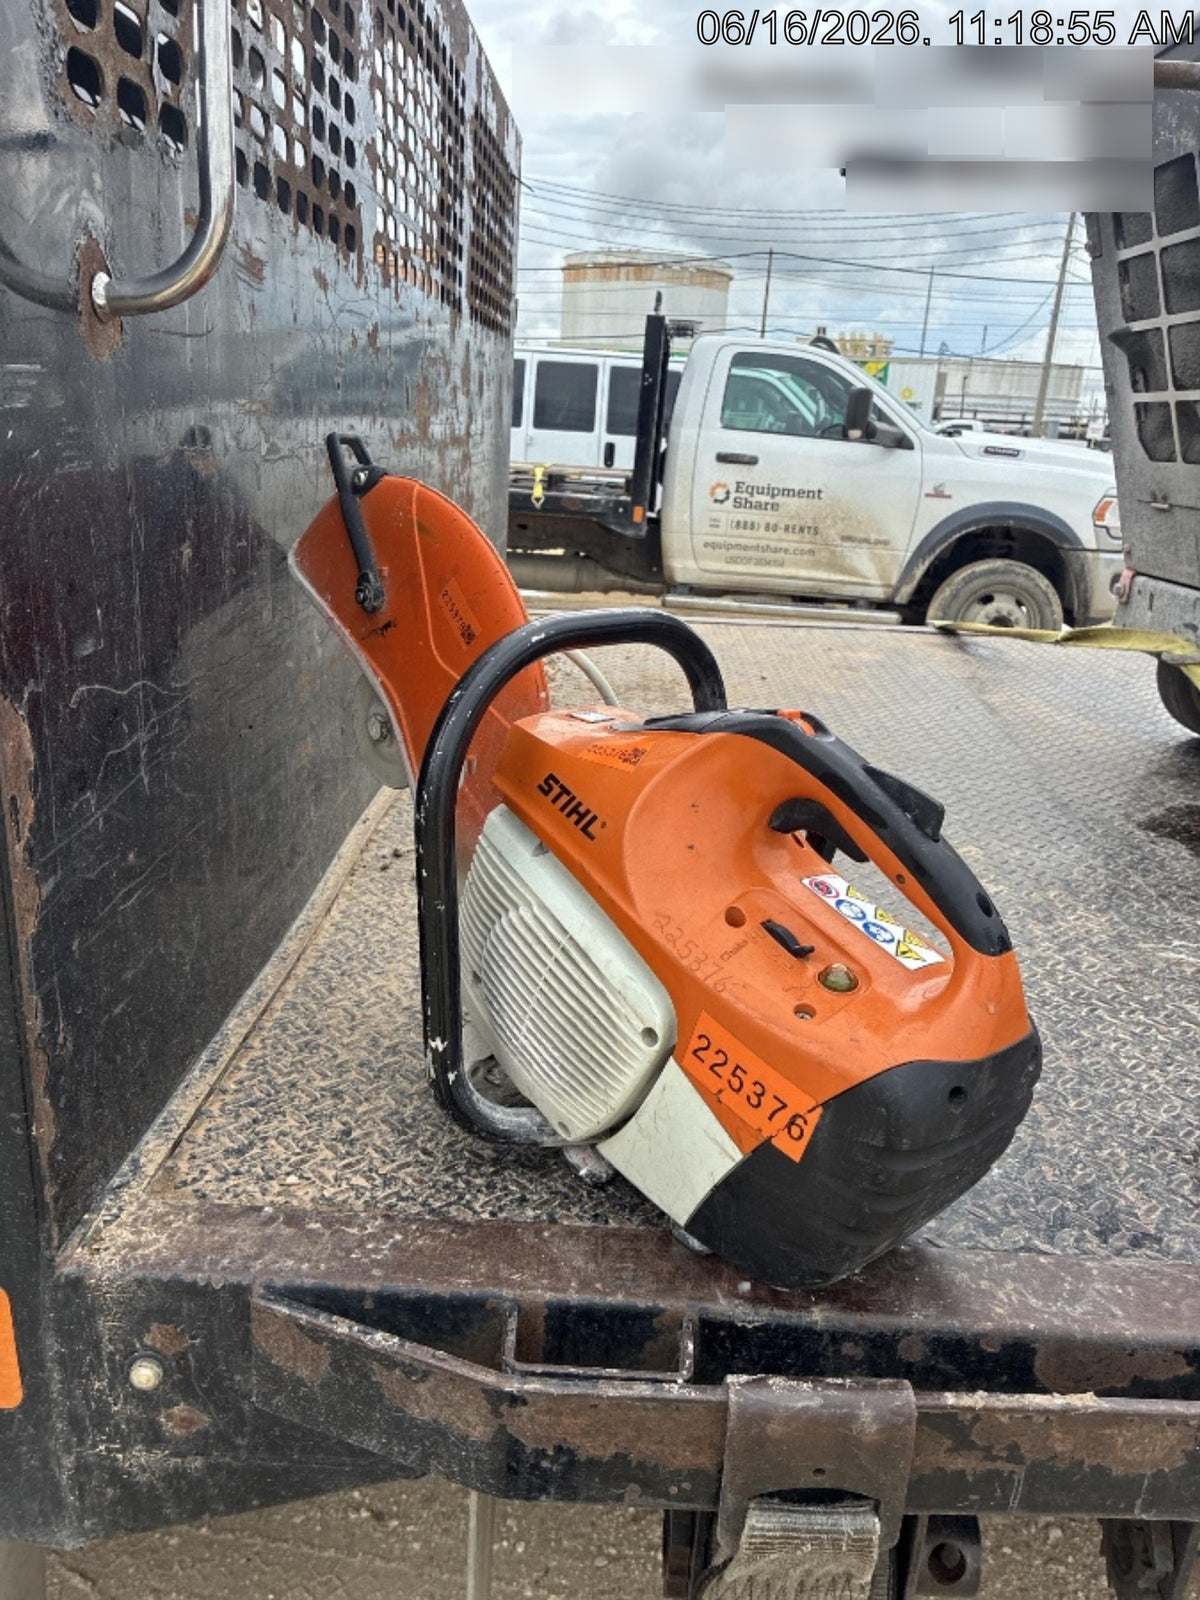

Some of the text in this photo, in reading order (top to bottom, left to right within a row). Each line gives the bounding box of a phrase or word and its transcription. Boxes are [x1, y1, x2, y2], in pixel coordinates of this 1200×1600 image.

[733, 495, 780, 512] Share
[735, 481, 824, 500] Equipment
[703, 541, 816, 557] equipmentshare.com
[536, 772, 599, 841] STIHL
[652, 911, 734, 993] 225376
[691, 1033, 809, 1141] 225376
